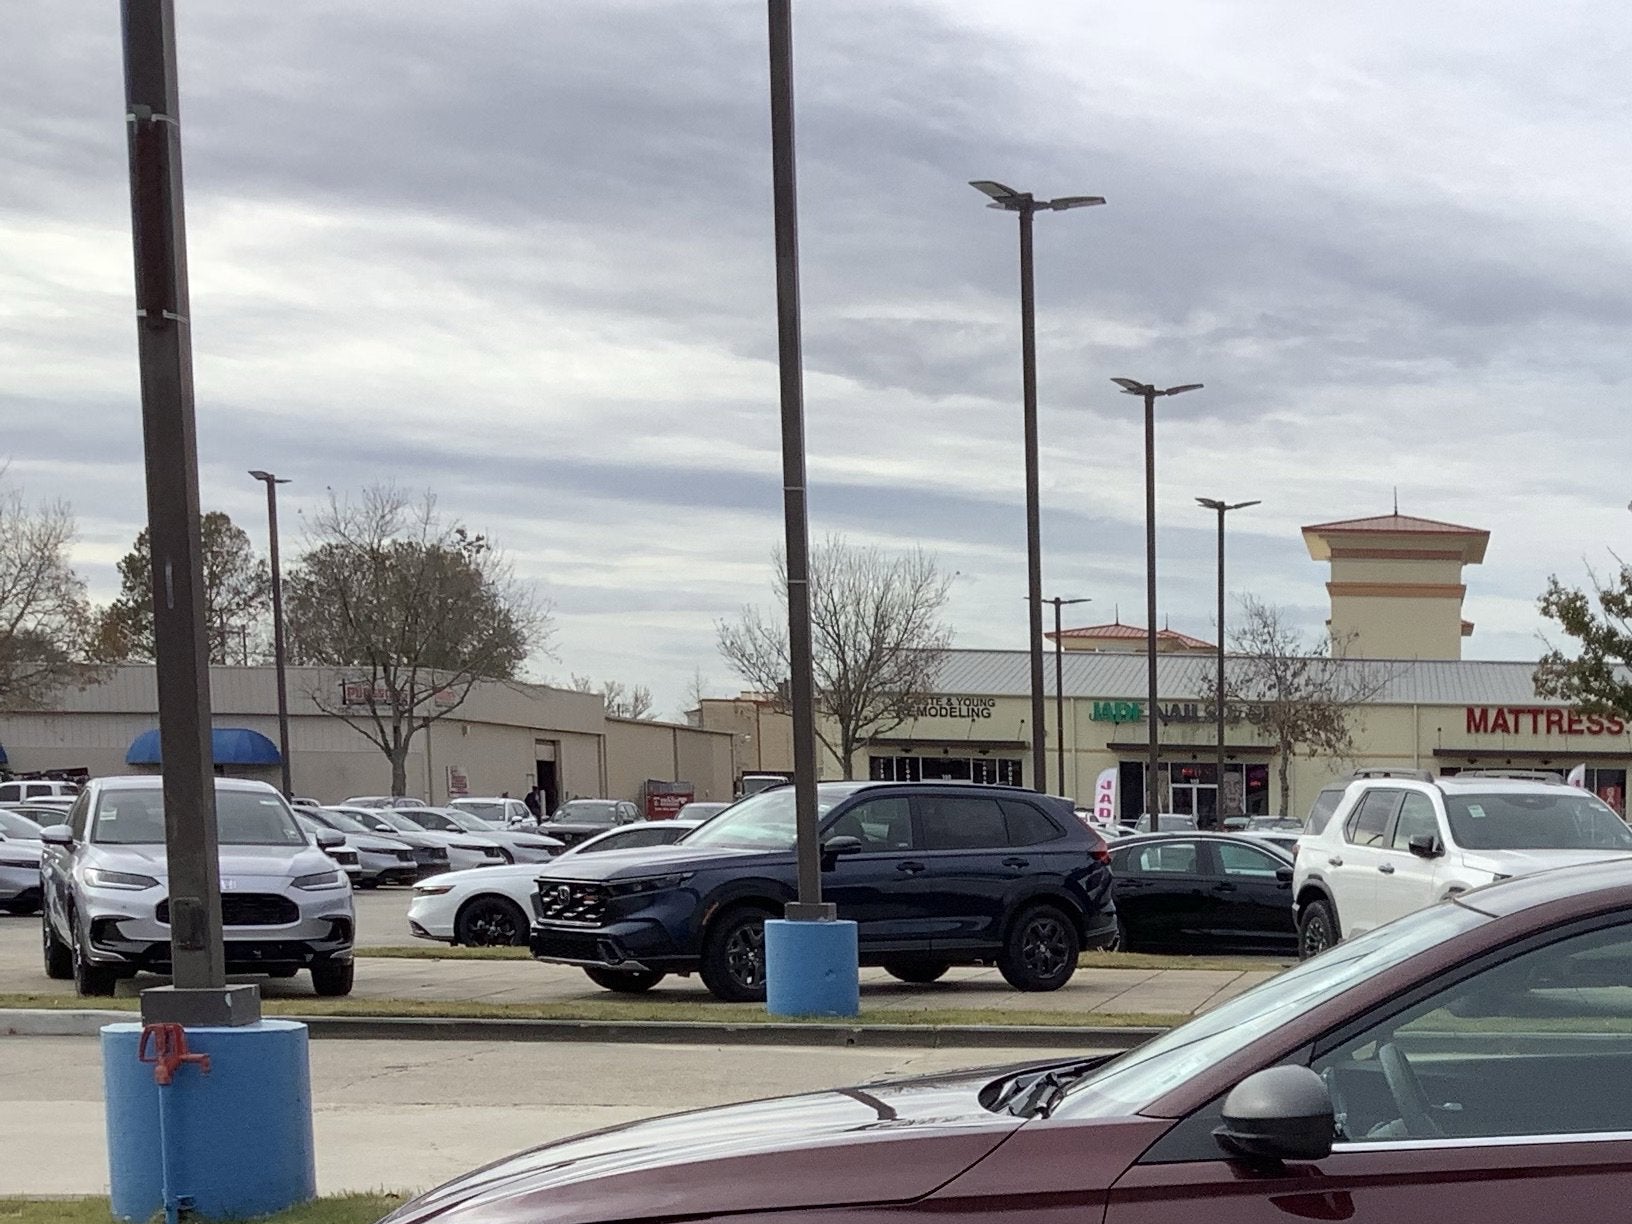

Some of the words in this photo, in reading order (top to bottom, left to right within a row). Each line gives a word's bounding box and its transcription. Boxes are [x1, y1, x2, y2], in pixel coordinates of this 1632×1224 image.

[945, 697, 954, 707] &
[956, 697, 996, 708] YOUNG
[1089, 701, 1148, 722] JADE
[1466, 706, 1625, 736] MATTRESS
